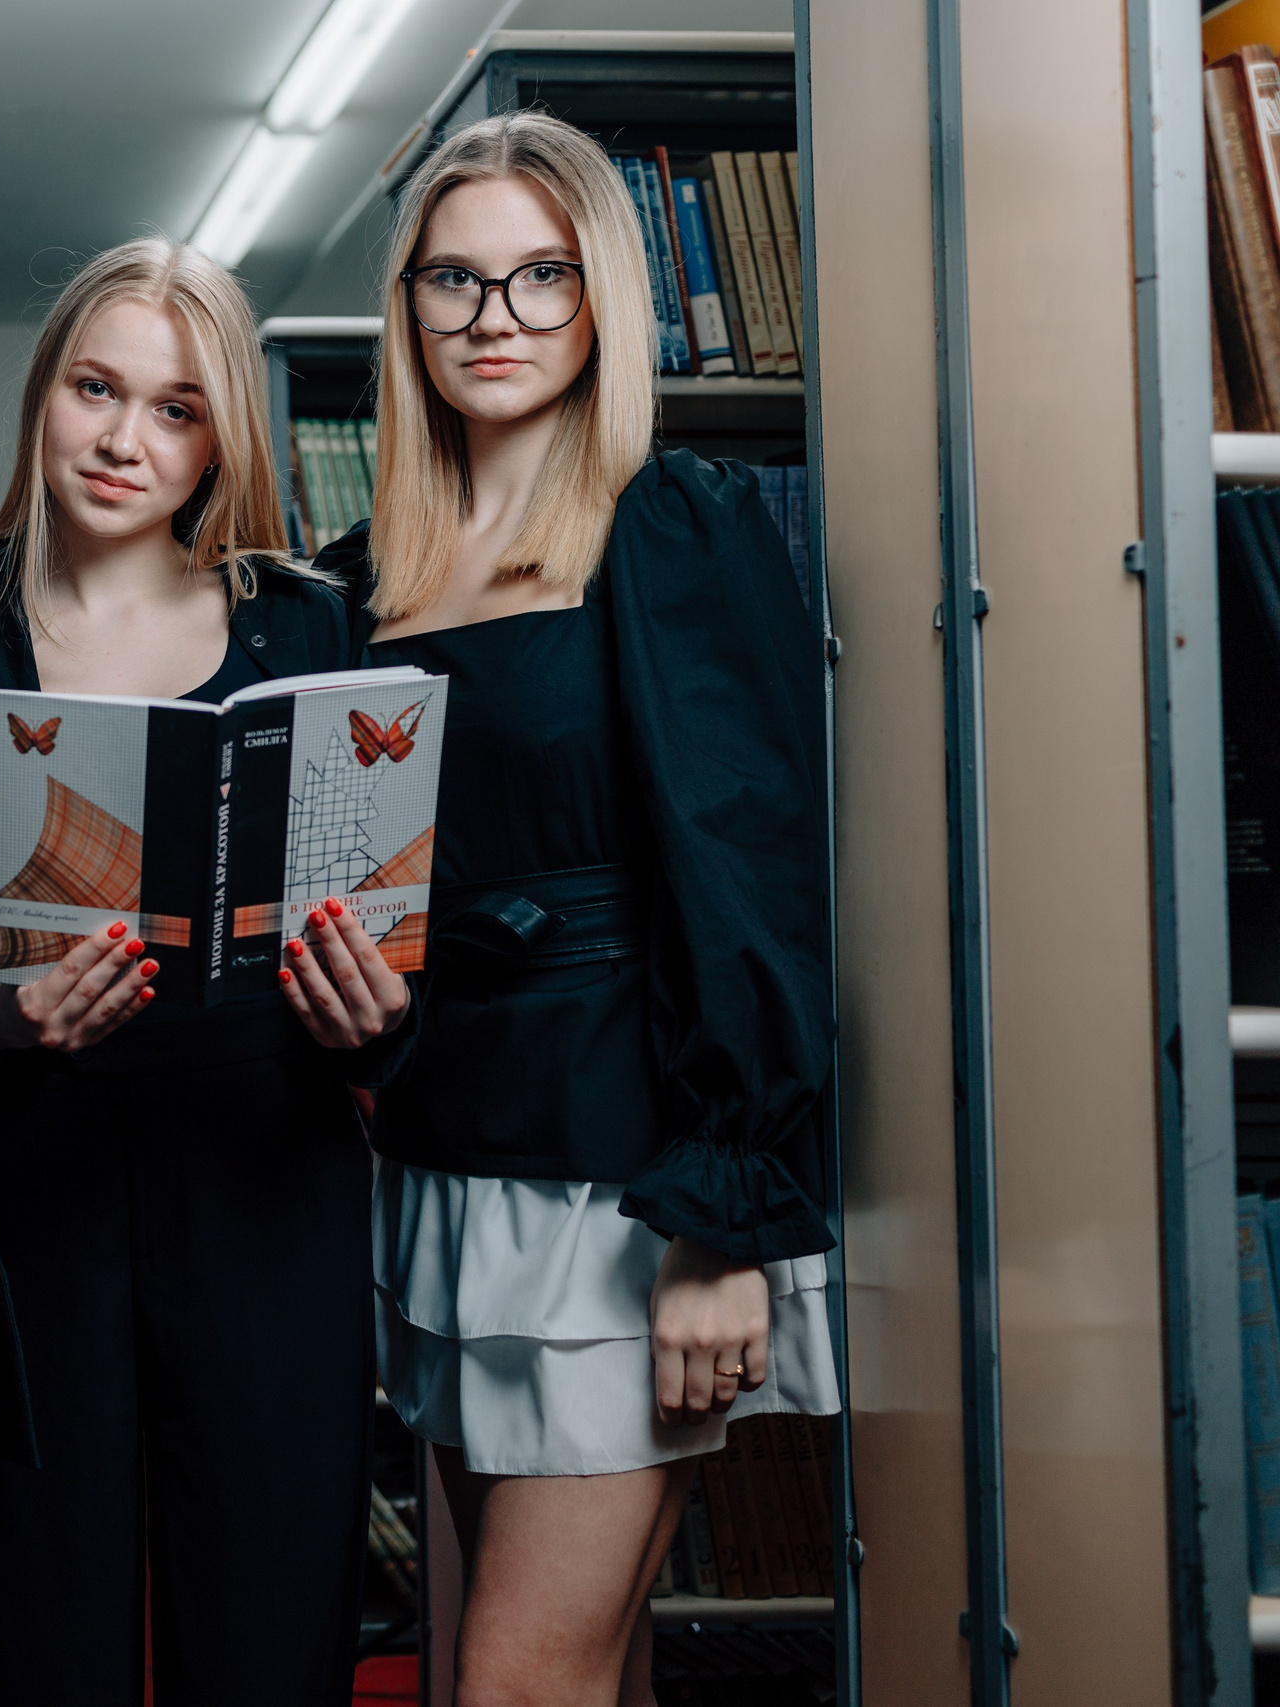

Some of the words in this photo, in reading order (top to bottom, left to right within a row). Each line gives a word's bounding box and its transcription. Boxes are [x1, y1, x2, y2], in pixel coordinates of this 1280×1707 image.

[244, 735, 288, 748] СМИЛГА
[215, 803, 230, 886] КРАСОТОЙ
[214, 886, 225, 906] ЗА
[290, 904, 298, 914] В
[303, 895, 364, 913] ПОНЕ
[212, 907, 224, 967] ПОГОНЕ
[210, 967, 221, 980] В
